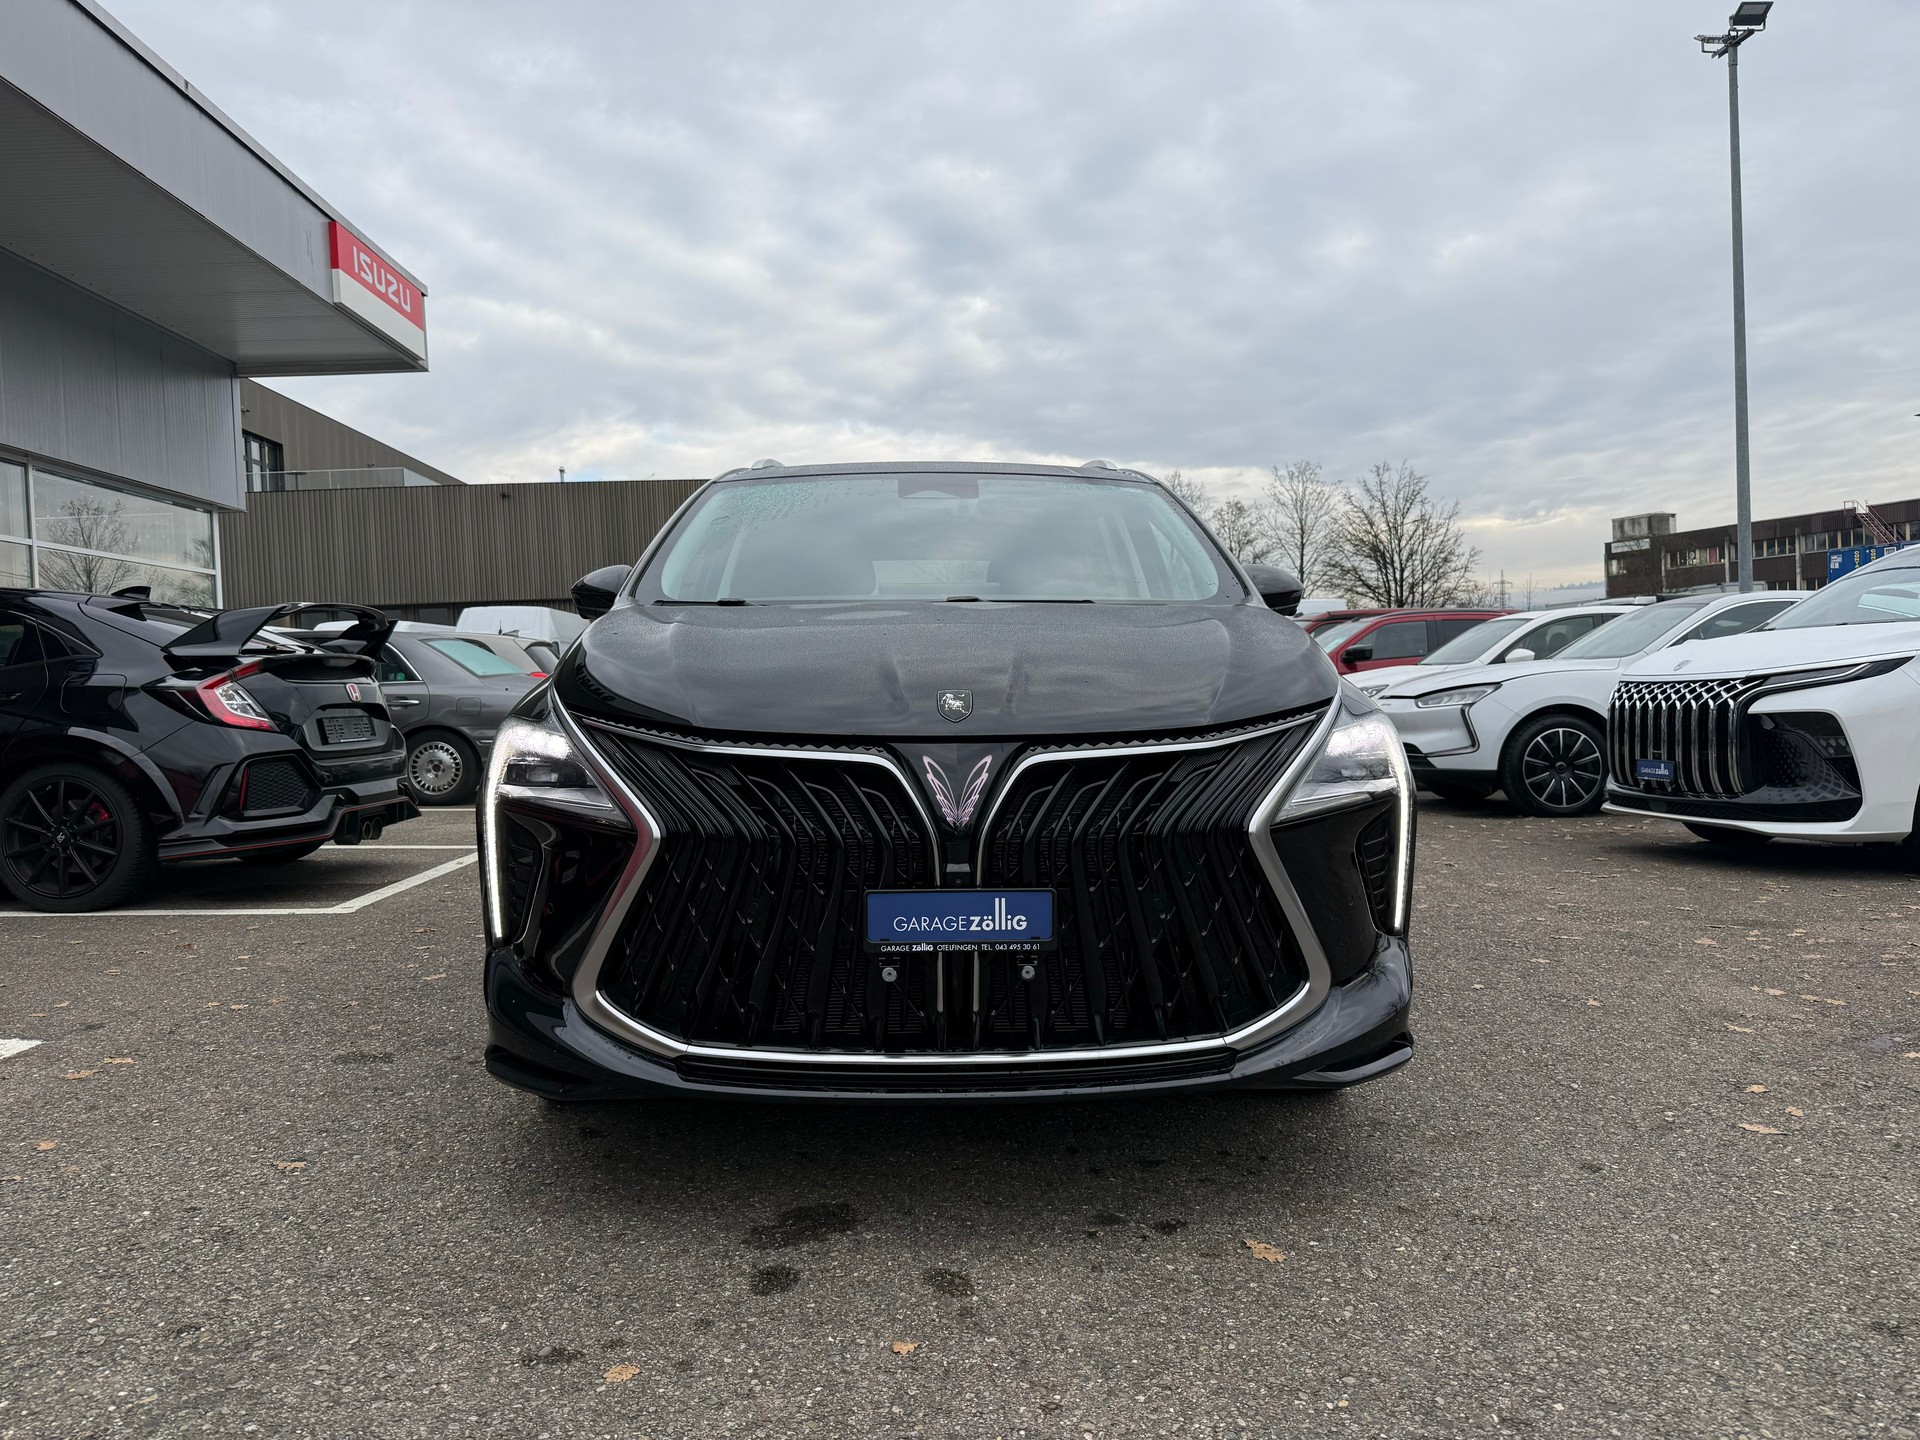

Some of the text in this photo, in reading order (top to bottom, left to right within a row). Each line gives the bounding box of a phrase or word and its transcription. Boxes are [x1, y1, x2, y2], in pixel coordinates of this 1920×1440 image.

[352, 245, 411, 313] ISUZU
[893, 916, 967, 932] GARAGE
[995, 943, 1007, 951] 043
[1009, 943, 1021, 951] 495
